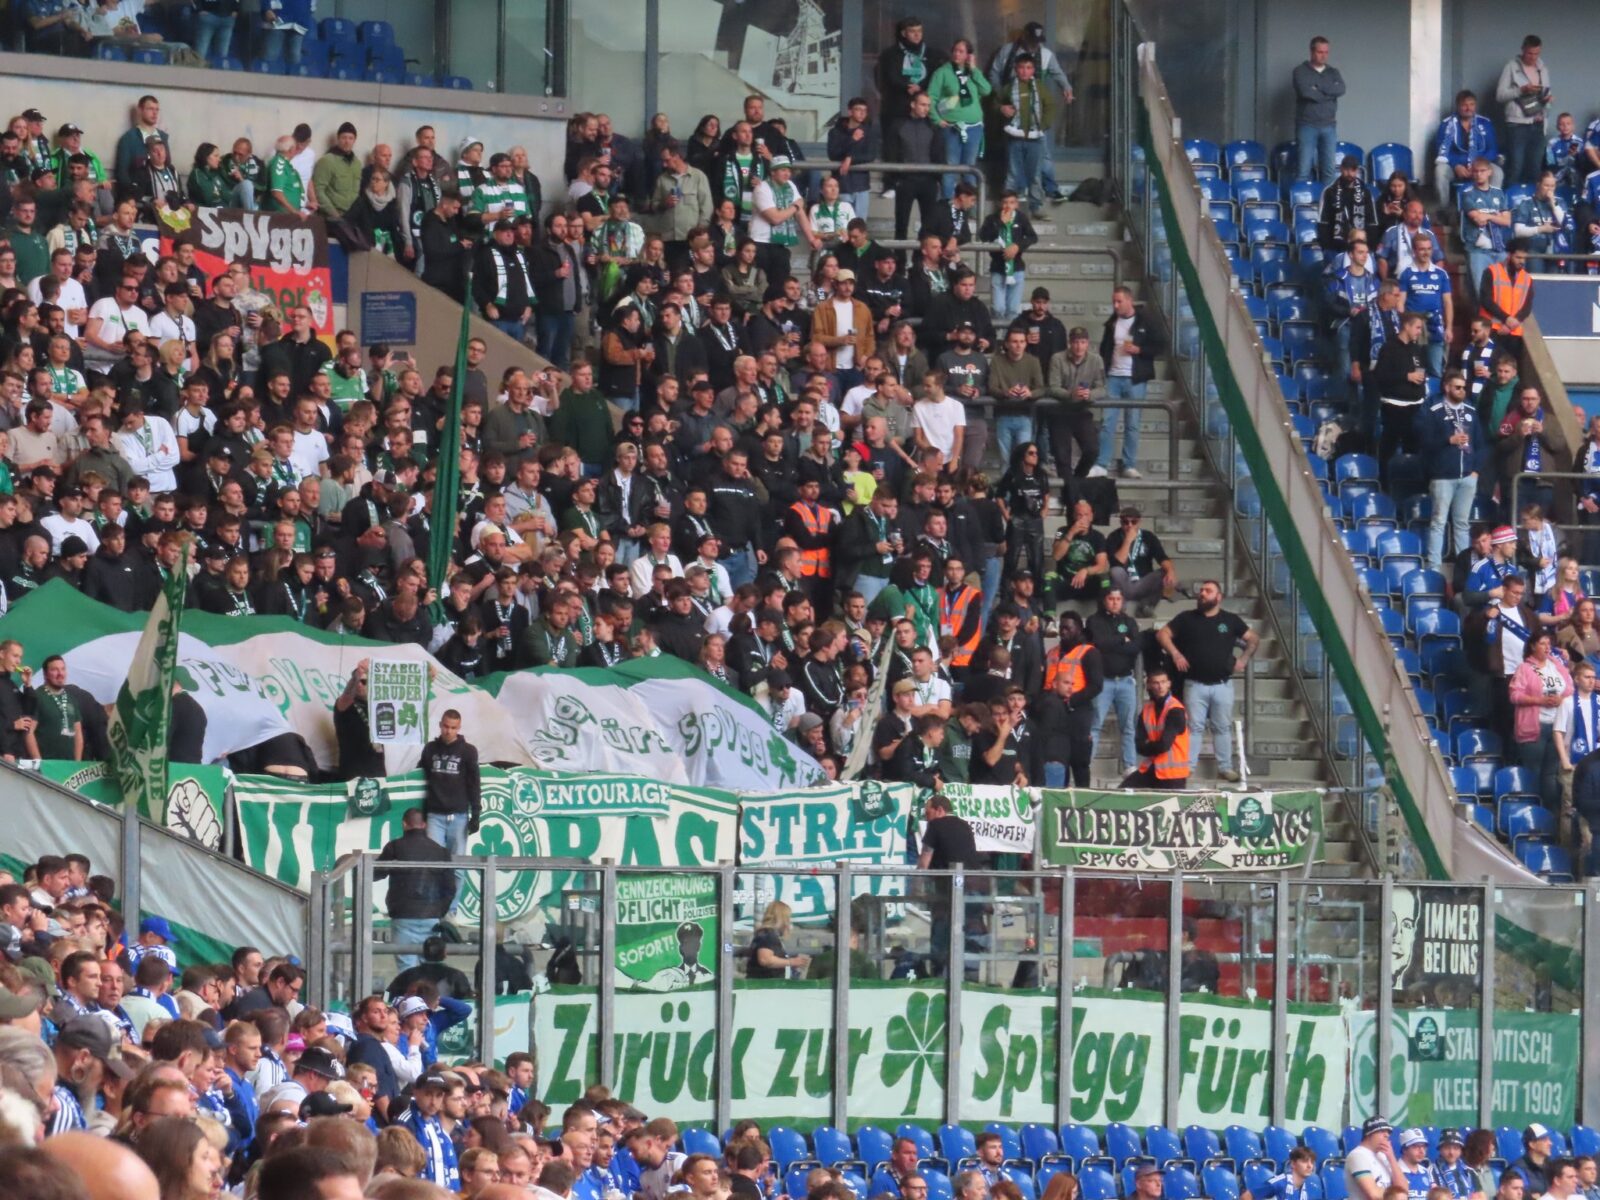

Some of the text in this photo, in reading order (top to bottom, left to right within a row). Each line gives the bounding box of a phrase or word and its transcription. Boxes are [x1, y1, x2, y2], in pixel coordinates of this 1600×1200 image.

[197, 206, 315, 275] SpVgg
[374, 663, 421, 673] STABIL
[374, 674, 421, 685] BLEIBEN
[374, 686, 421, 700] BRUDER
[546, 783, 671, 805] ENTOURAGE
[1055, 807, 1224, 848] KLEEBLATT
[1079, 851, 1139, 868] SPVGG
[616, 876, 715, 899] KENNZEICHNUNGS
[617, 899, 681, 923] PFLICHT
[1424, 902, 1479, 941] IMMER
[618, 935, 675, 967] SOFORT!
[1423, 941, 1478, 975] BEI UNS
[545, 993, 755, 1104] Zurück
[767, 1026, 873, 1098] zur
[972, 1003, 1151, 1122] SpVgg
[1523, 1081, 1562, 1115] 1903
